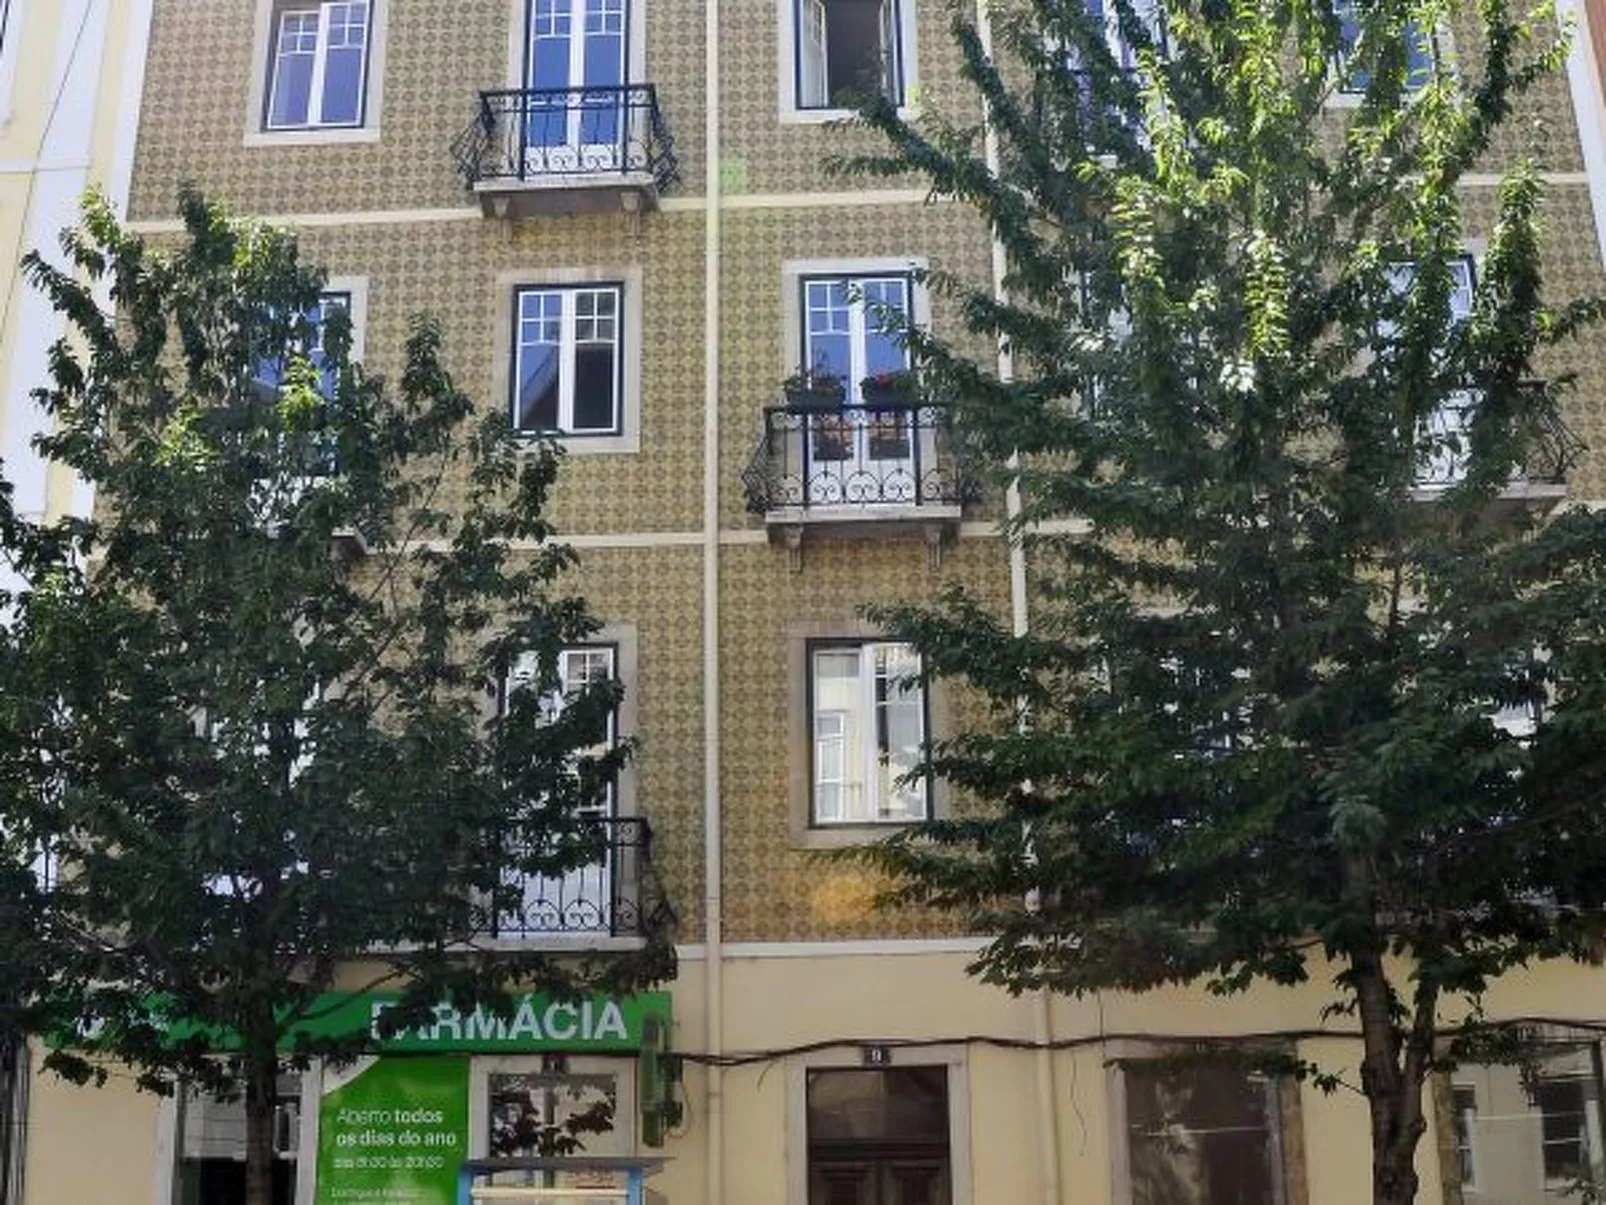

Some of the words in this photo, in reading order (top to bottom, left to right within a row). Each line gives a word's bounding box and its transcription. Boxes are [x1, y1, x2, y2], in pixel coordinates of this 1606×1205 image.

[394, 1107, 444, 1124] todos
[336, 1131, 357, 1147] os
[359, 1129, 395, 1147] dias
[398, 1129, 421, 1147] do
[424, 1131, 457, 1147] ano
